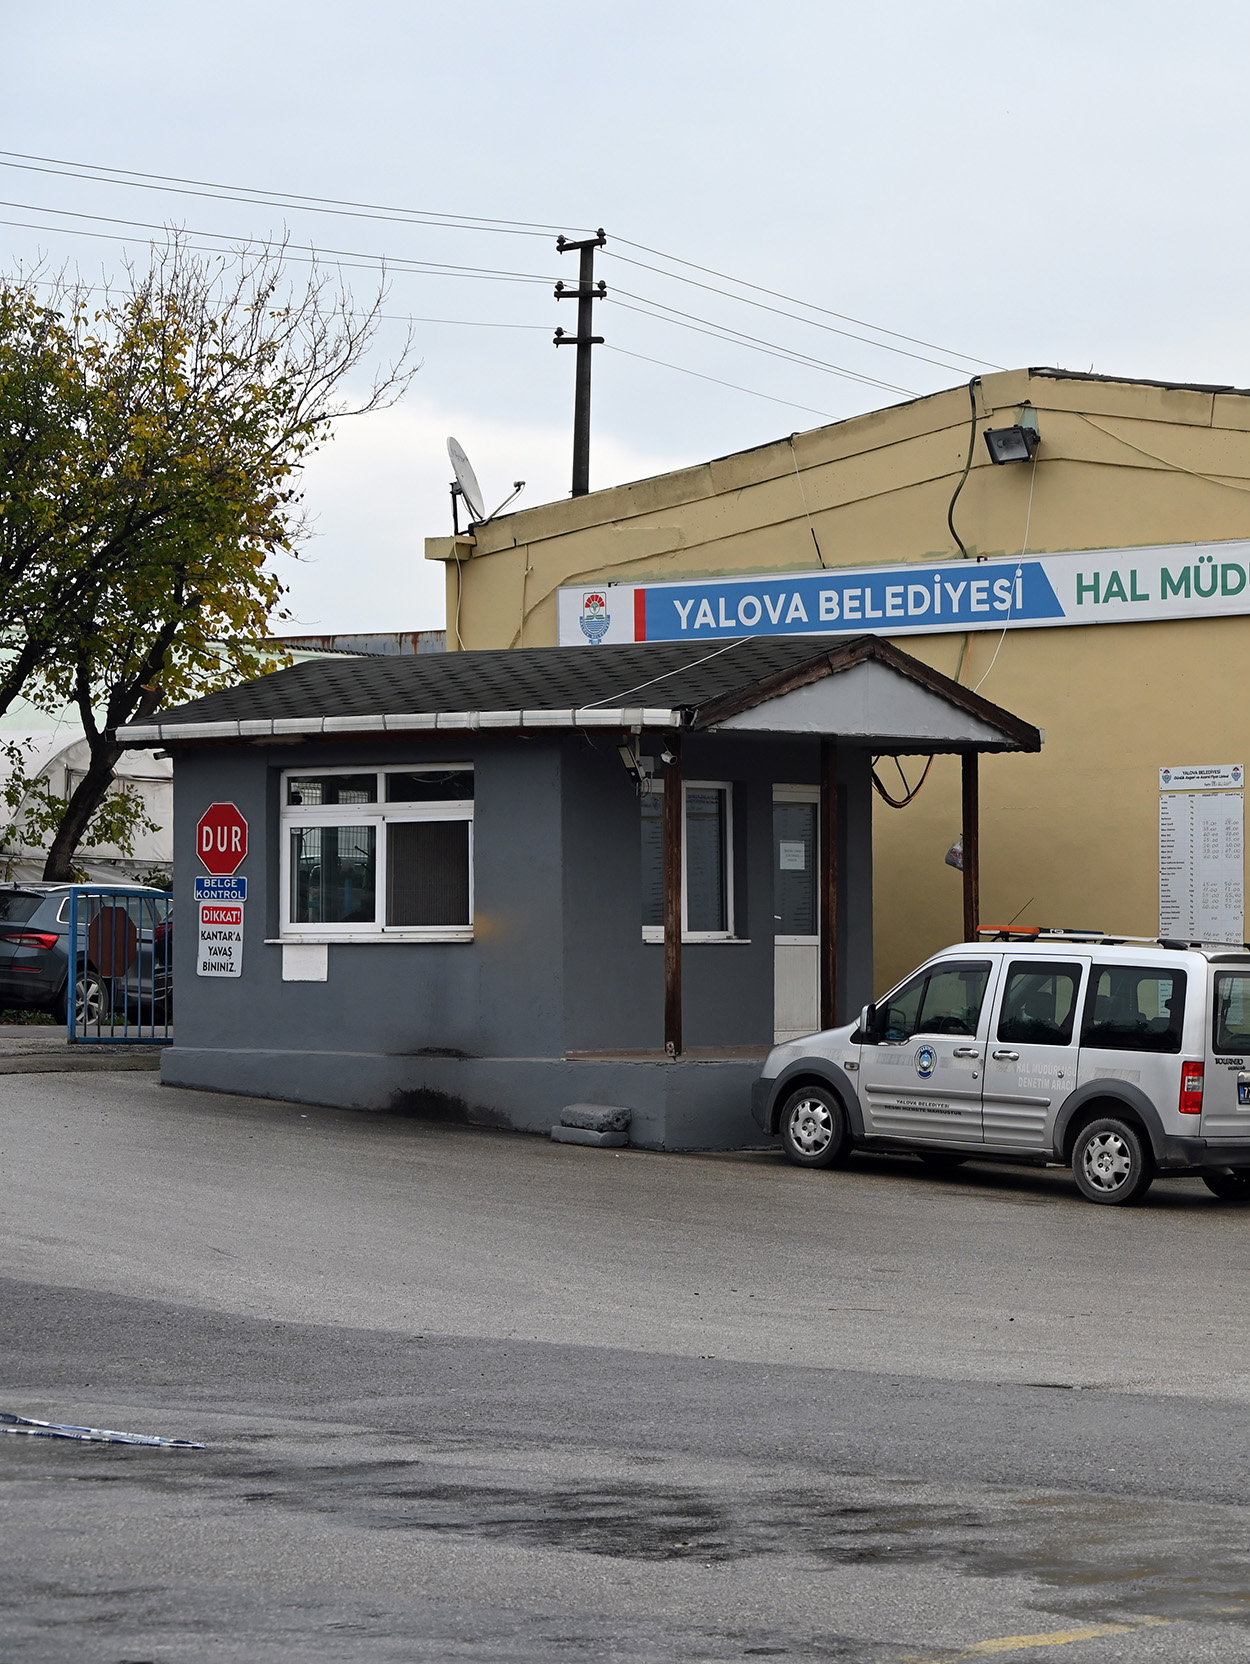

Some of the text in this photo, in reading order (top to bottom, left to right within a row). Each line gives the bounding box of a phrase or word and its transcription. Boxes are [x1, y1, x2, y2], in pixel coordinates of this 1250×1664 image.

[1076, 568, 1150, 605] HAL
[673, 569, 1024, 630] YALOVA BELEDİYESİ
[202, 826, 242, 852] DUR
[204, 879, 238, 888] BELGE
[196, 890, 245, 900] KONTROL
[203, 907, 242, 923] DİKKAT!
[201, 930, 241, 941] KANTAR'A
[208, 946, 232, 960] YAVAŞ
[1016, 1063, 1031, 1074] HAL
[1018, 1076, 1050, 1089] DENETİM
